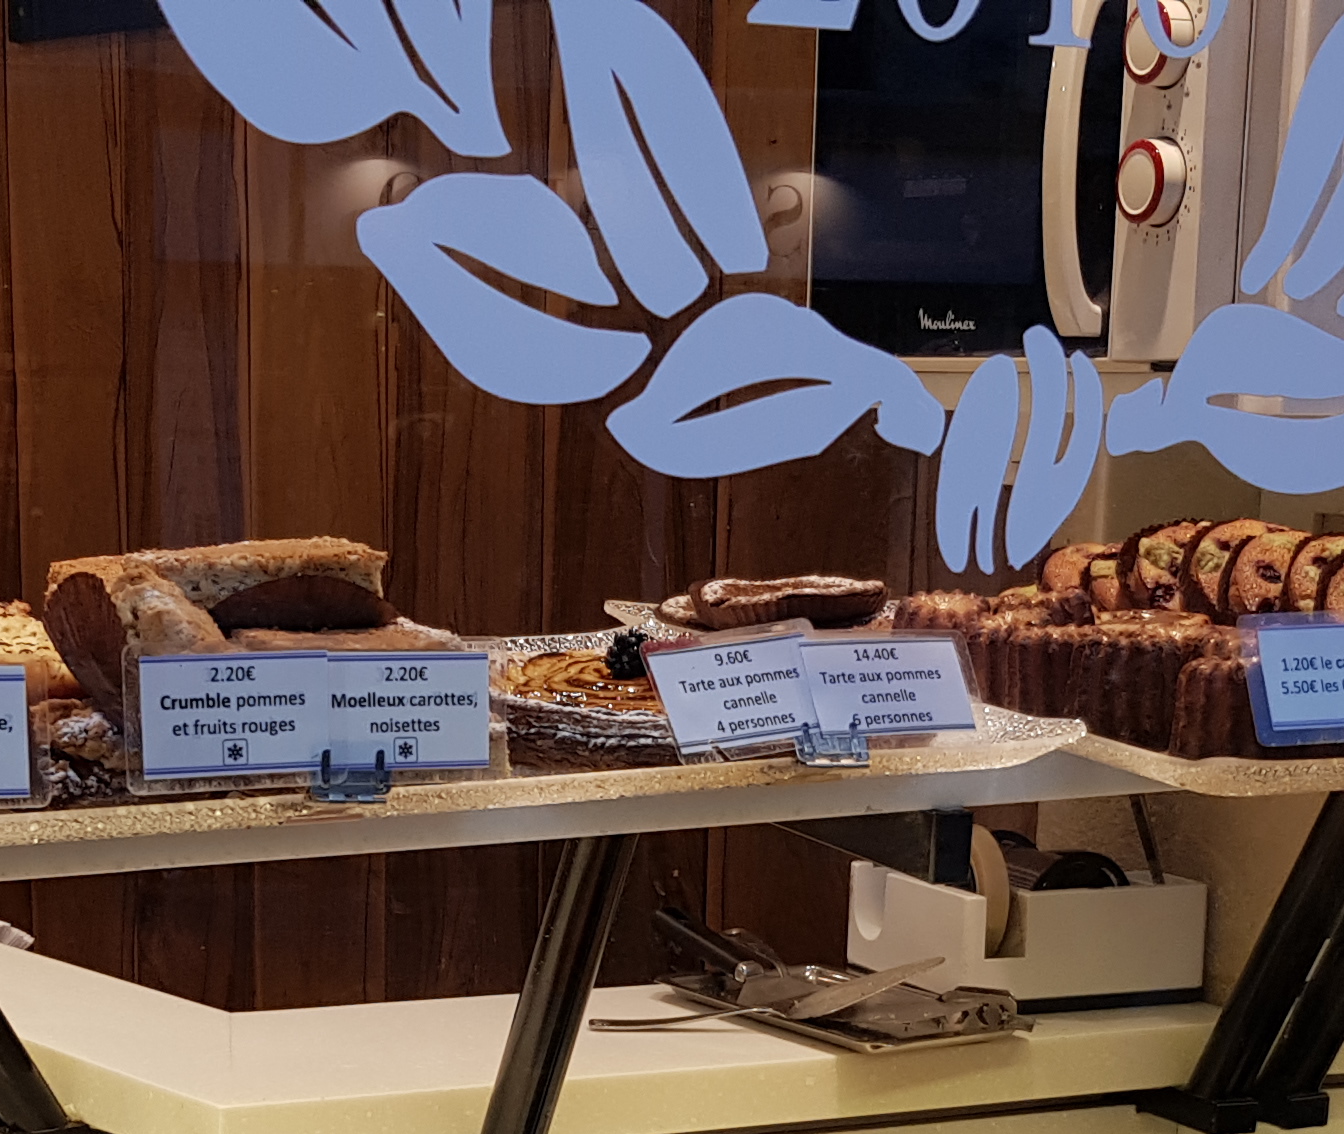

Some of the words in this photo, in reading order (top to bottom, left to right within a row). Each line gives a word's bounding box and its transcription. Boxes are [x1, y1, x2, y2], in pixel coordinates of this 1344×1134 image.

[918, 307, 976, 331] Moulinex
[714, 650, 752, 666] 9.60€
[854, 647, 899, 662] 14.40€
[1282, 656, 1318, 672] 1.20€
[1321, 657, 1333, 670] le
[210, 666, 256, 682] 2.20€
[384, 666, 429, 682] 2.20€
[678, 677, 716, 694] Tarte
[719, 675, 743, 689] aux
[745, 666, 800, 686] pommes
[819, 670, 855, 685] Tarte
[859, 671, 882, 683] aux
[886, 668, 942, 685] pommes
[1281, 680, 1319, 695] 5.50€
[1321, 679, 1339, 692] les
[160, 693, 231, 711] Crumble
[236, 693, 306, 711] pommes
[331, 693, 405, 708] Moelleux
[409, 692, 478, 709] carottes,
[723, 691, 777, 711] cannelle
[862, 689, 916, 704] cannelle
[370, 718, 440, 733] noisettes
[716, 721, 726, 733] 4
[729, 712, 796, 734] personnes
[864, 710, 933, 727] personnes
[172, 722, 190, 736] et
[194, 719, 237, 735] fruits
[241, 719, 296, 737] rouges
